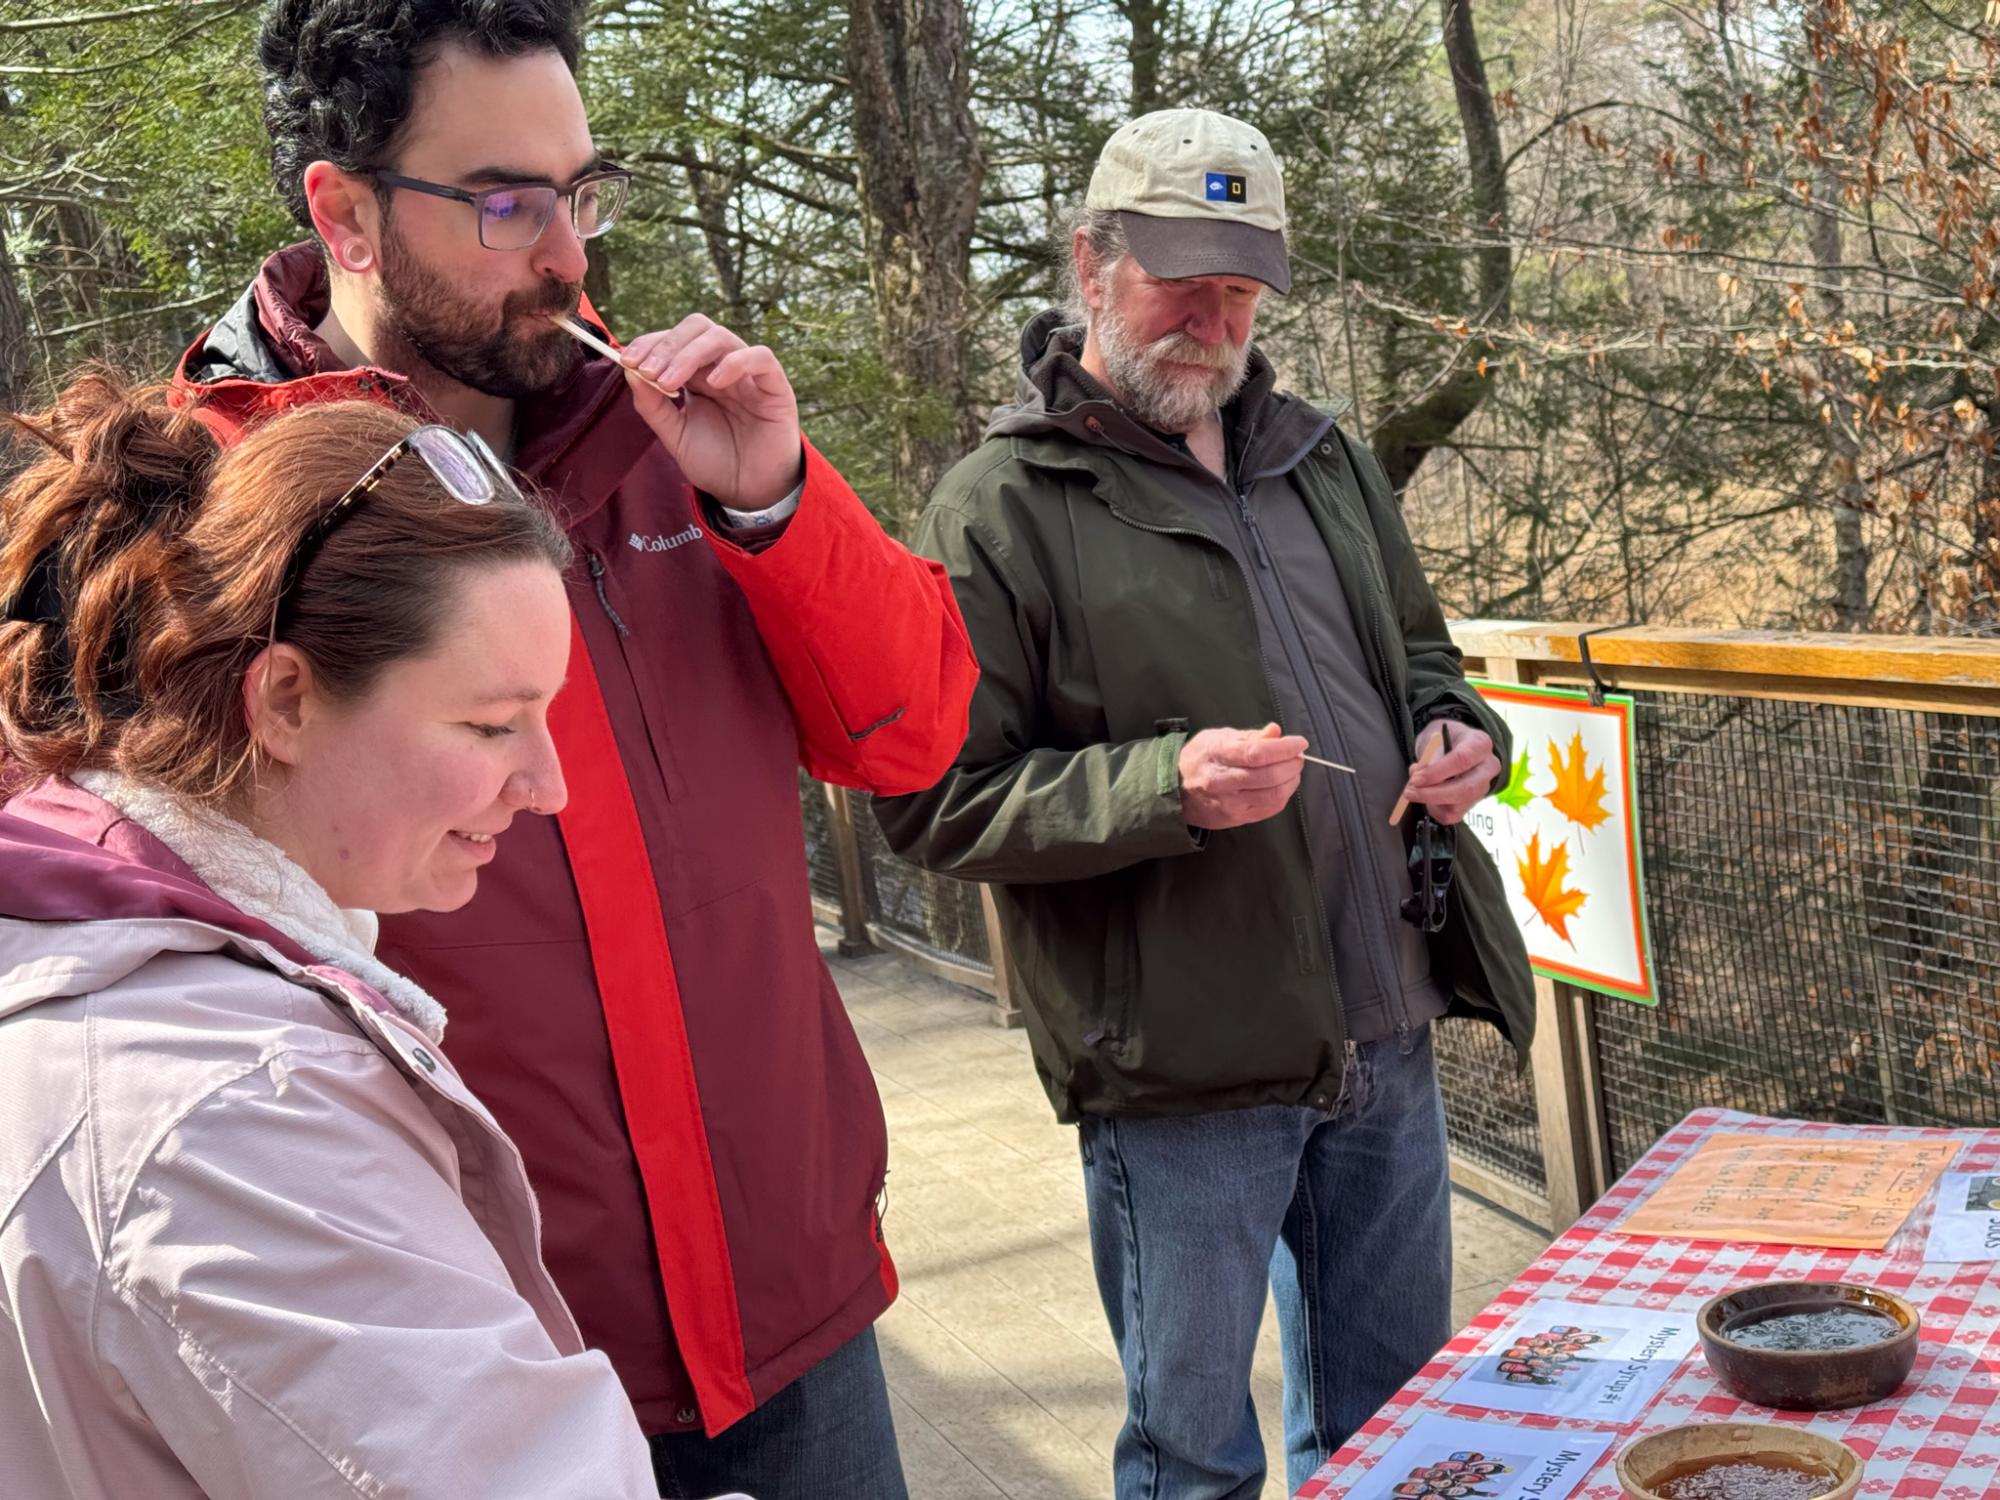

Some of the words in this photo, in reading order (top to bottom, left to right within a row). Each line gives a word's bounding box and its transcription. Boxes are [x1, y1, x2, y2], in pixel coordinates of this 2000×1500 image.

[642, 523, 703, 552] Columb
[1629, 1327, 1681, 1363] Mystery
[1604, 1364, 1648, 1392] Syrup
[1522, 1450, 1582, 1495] Mystery
